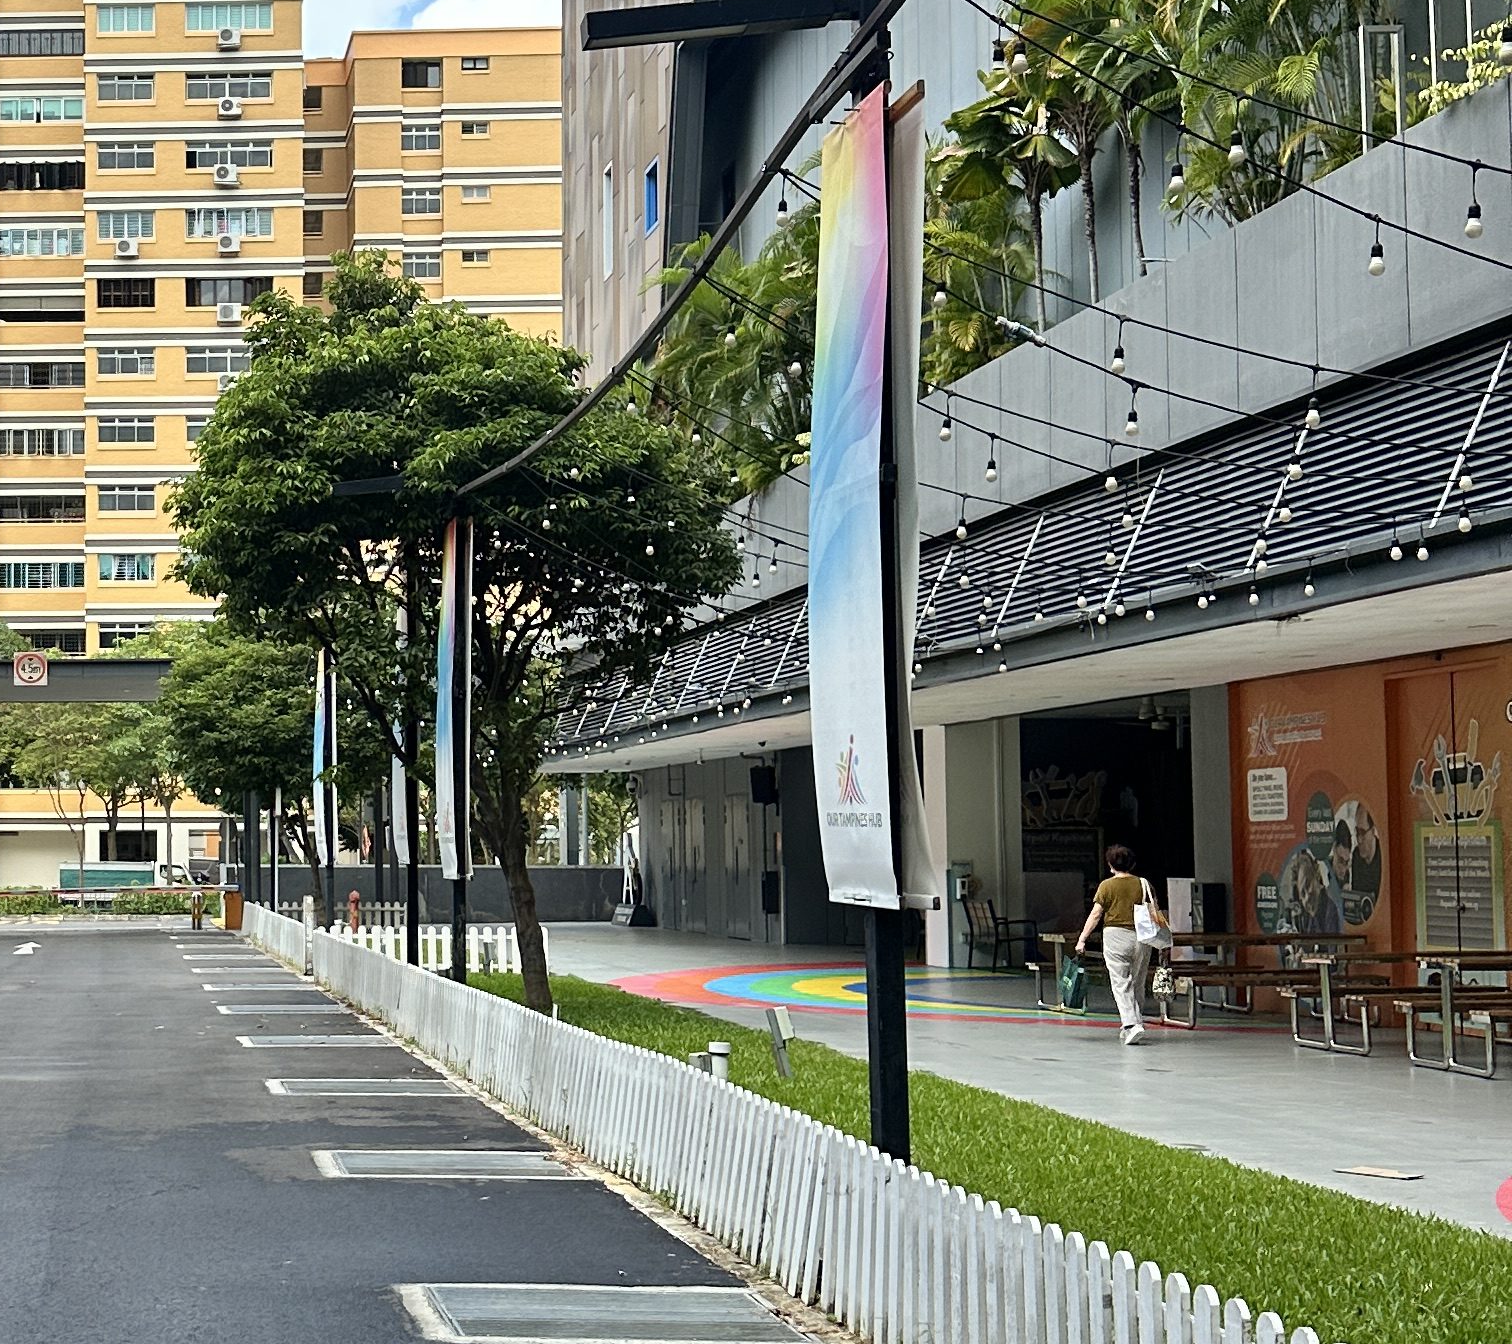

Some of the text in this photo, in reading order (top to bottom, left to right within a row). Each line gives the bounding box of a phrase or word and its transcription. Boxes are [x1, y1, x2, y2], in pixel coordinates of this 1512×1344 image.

[21, 663, 41, 674] 4.5m
[826, 812, 883, 827] OUR TAMPINES HUB
[1306, 821, 1334, 833] SUNDAY
[1257, 885, 1277, 900] FREE
